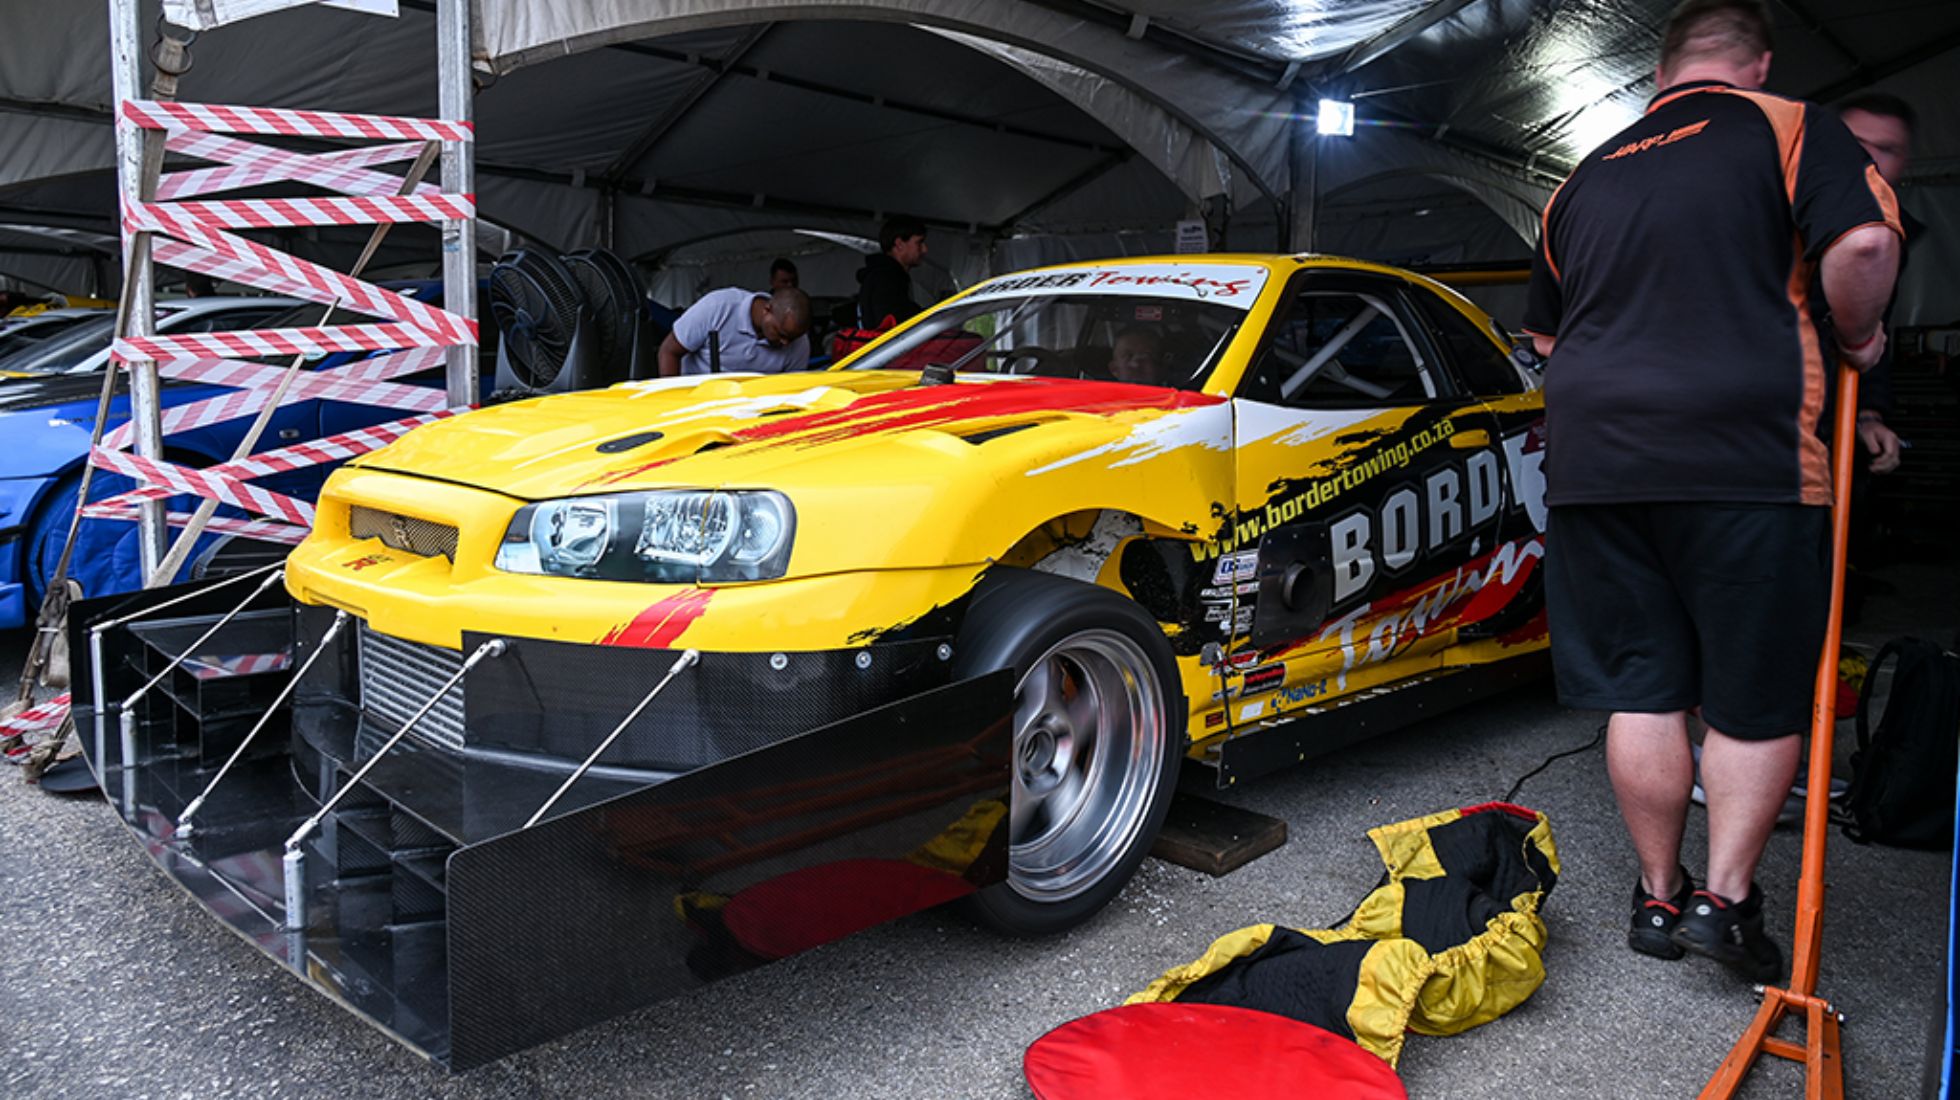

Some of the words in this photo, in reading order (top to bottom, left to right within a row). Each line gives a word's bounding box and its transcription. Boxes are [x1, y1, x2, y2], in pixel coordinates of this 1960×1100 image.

[1090, 271, 1251, 296] Towing
[1188, 418, 1456, 562] www.bordertowing.co.za
[1319, 536, 1545, 691] Towin
